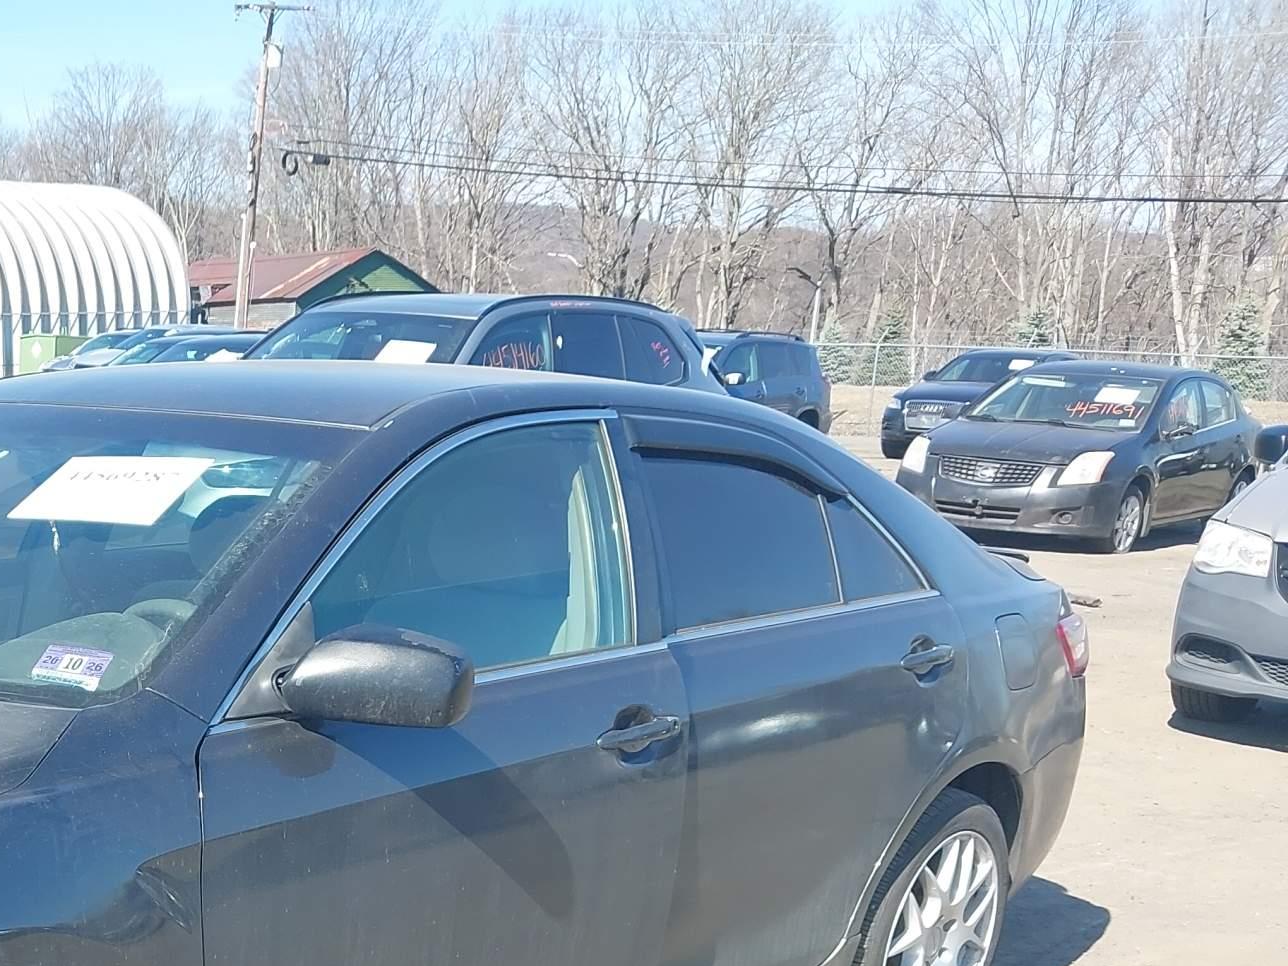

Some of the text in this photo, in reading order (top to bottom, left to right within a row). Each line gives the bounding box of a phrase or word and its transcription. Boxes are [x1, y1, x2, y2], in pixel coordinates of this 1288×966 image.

[1065, 401, 1145, 420] 44511691
[42, 655, 104, 672] 20 10 26
